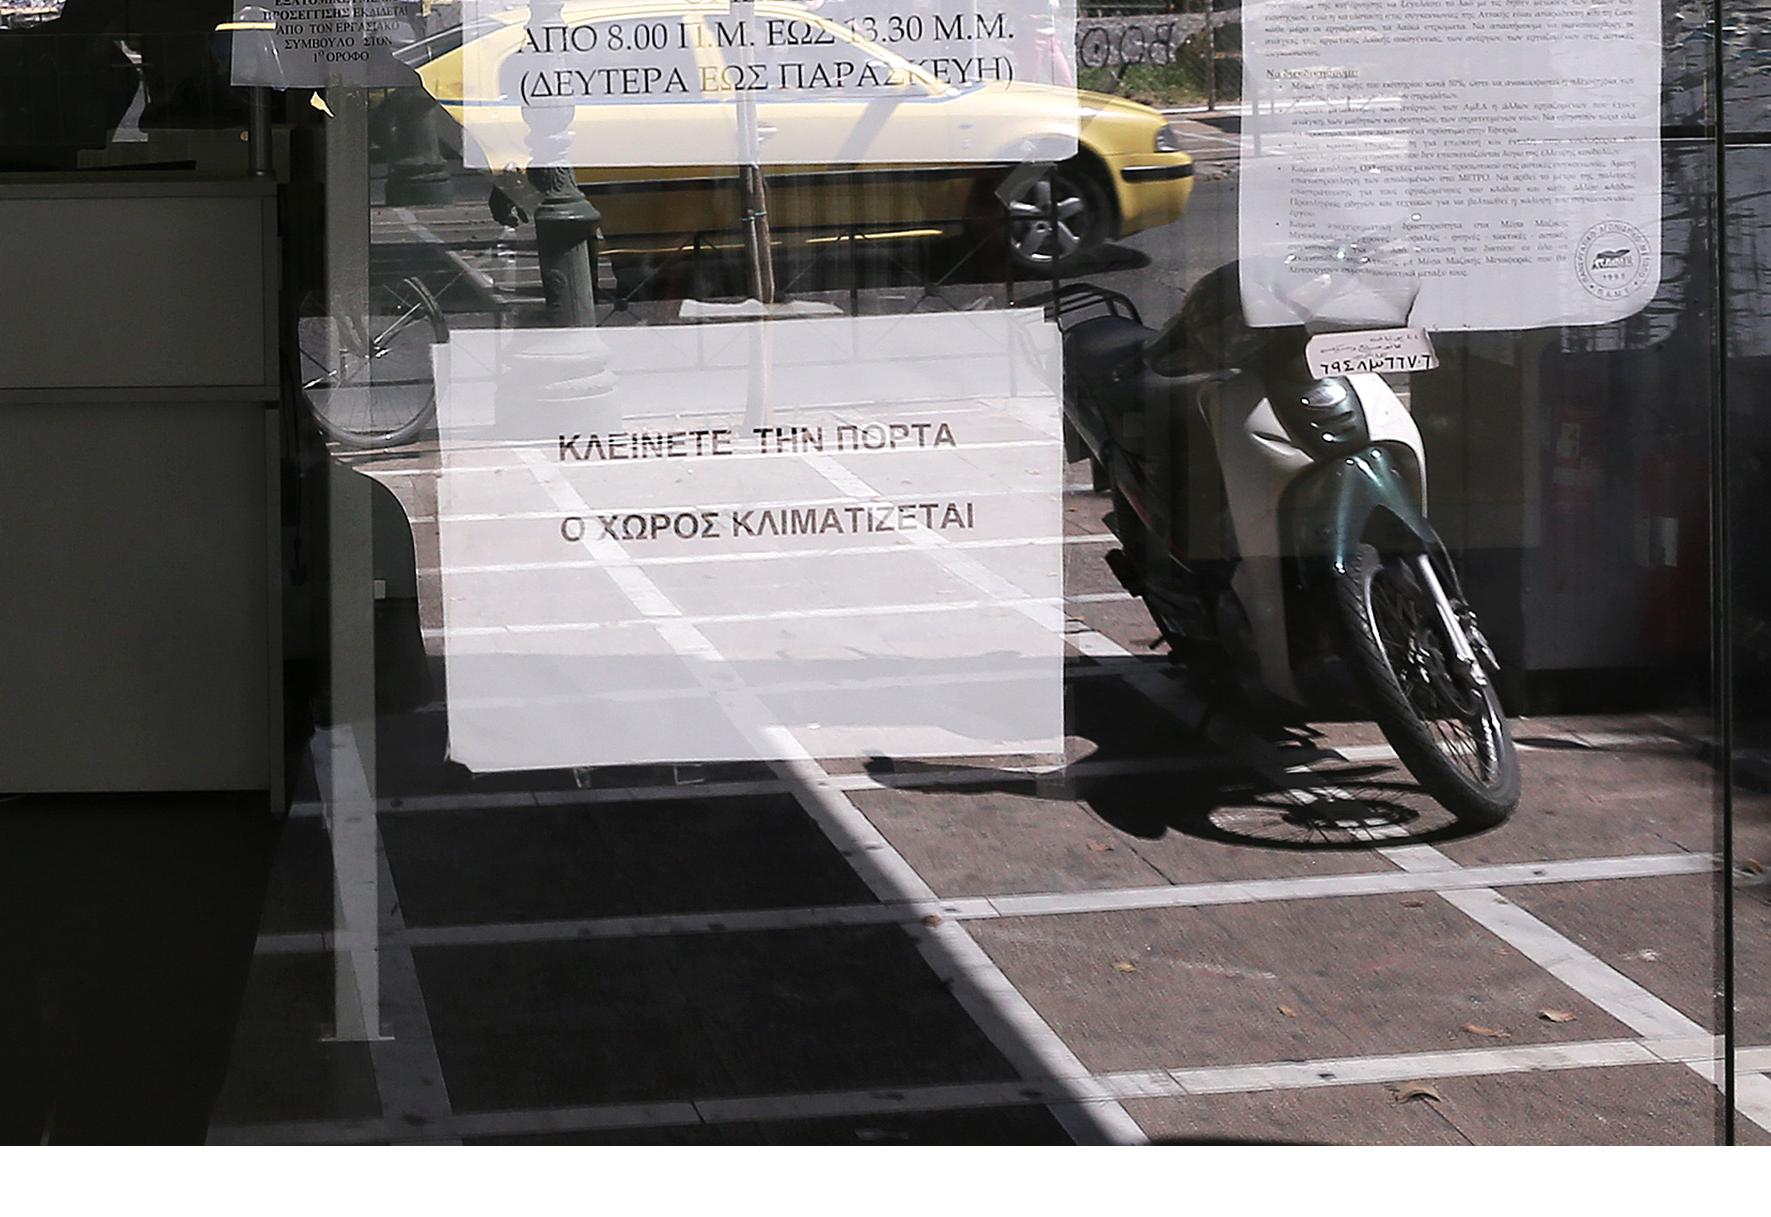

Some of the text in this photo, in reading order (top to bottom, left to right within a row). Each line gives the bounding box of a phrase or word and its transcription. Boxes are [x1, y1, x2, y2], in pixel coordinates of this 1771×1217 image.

[263, 5, 409, 21] ΠΡΟΣΕΓΓΙΣΗΣ ΕΚΔΙΔΕΤΑΙ
[276, 21, 400, 35] ΑΠΟ ΤΟΝ ΕΡΓΑΣΙΑΚΟ
[516, 24, 598, 55] ΑΠΟ
[607, 23, 669, 52] 8.00
[765, 18, 836, 47] ΕΩΣ
[844, 15, 924, 44] 13.30
[932, 13, 1015, 42] Μ.Μ.
[284, 36, 393, 49] ΣΥΜΒΟΥΛΟ ΣΤΟΝ
[327, 50, 370, 63] ΟΡΟΦΟ
[520, 66, 689, 106] (ΔΕΥΤΕΡΑ
[700, 64, 770, 92] ΕΩΣ
[558, 422, 958, 462] ΚΛΕΙΝΕΤΕ ΤΗΝ ΠΟΡΤΑ
[560, 501, 975, 543] Ο ΧΩΡΟΣ ΚΛΙΜΑΤΙΖΕΤΑΙ
